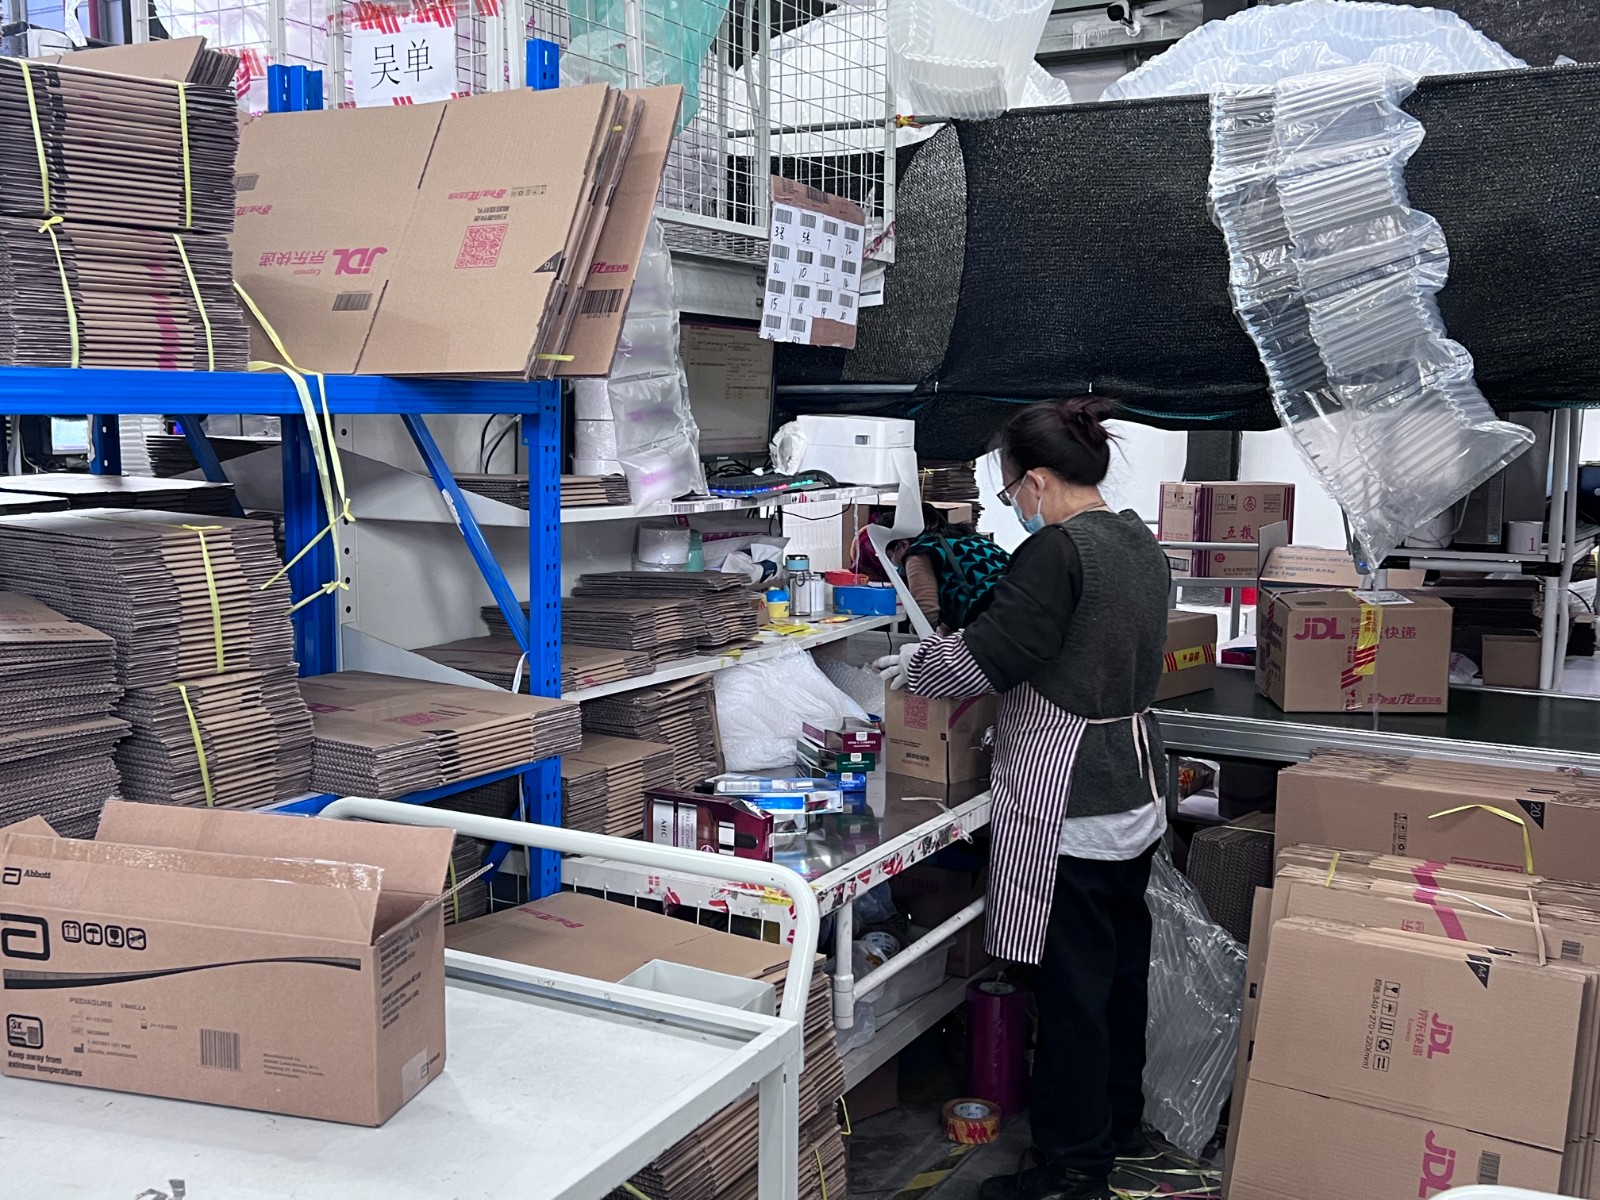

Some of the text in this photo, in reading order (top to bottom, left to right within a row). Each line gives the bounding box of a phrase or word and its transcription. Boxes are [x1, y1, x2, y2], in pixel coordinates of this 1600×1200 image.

[370, 39, 433, 89] 吴单
[259, 250, 328, 267] 京东快递
[332, 246, 388, 275] JDL
[544, 261, 553, 270] 16
[1528, 537, 1536, 552] 1
[1293, 617, 1346, 640] JDL
[1530, 803, 1541, 817] 20
[23, 869, 52, 879] Abbott
[69, 997, 147, 1011] PEDIASURE VANILLA
[1412, 1008, 1428, 1056] 京东快递
[1427, 1012, 1454, 1060] JDL
[8, 1050, 62, 1064] Keep away from
[8, 1061, 82, 1077] extreme temperatures
[1418, 1129, 1456, 1199] JDL
